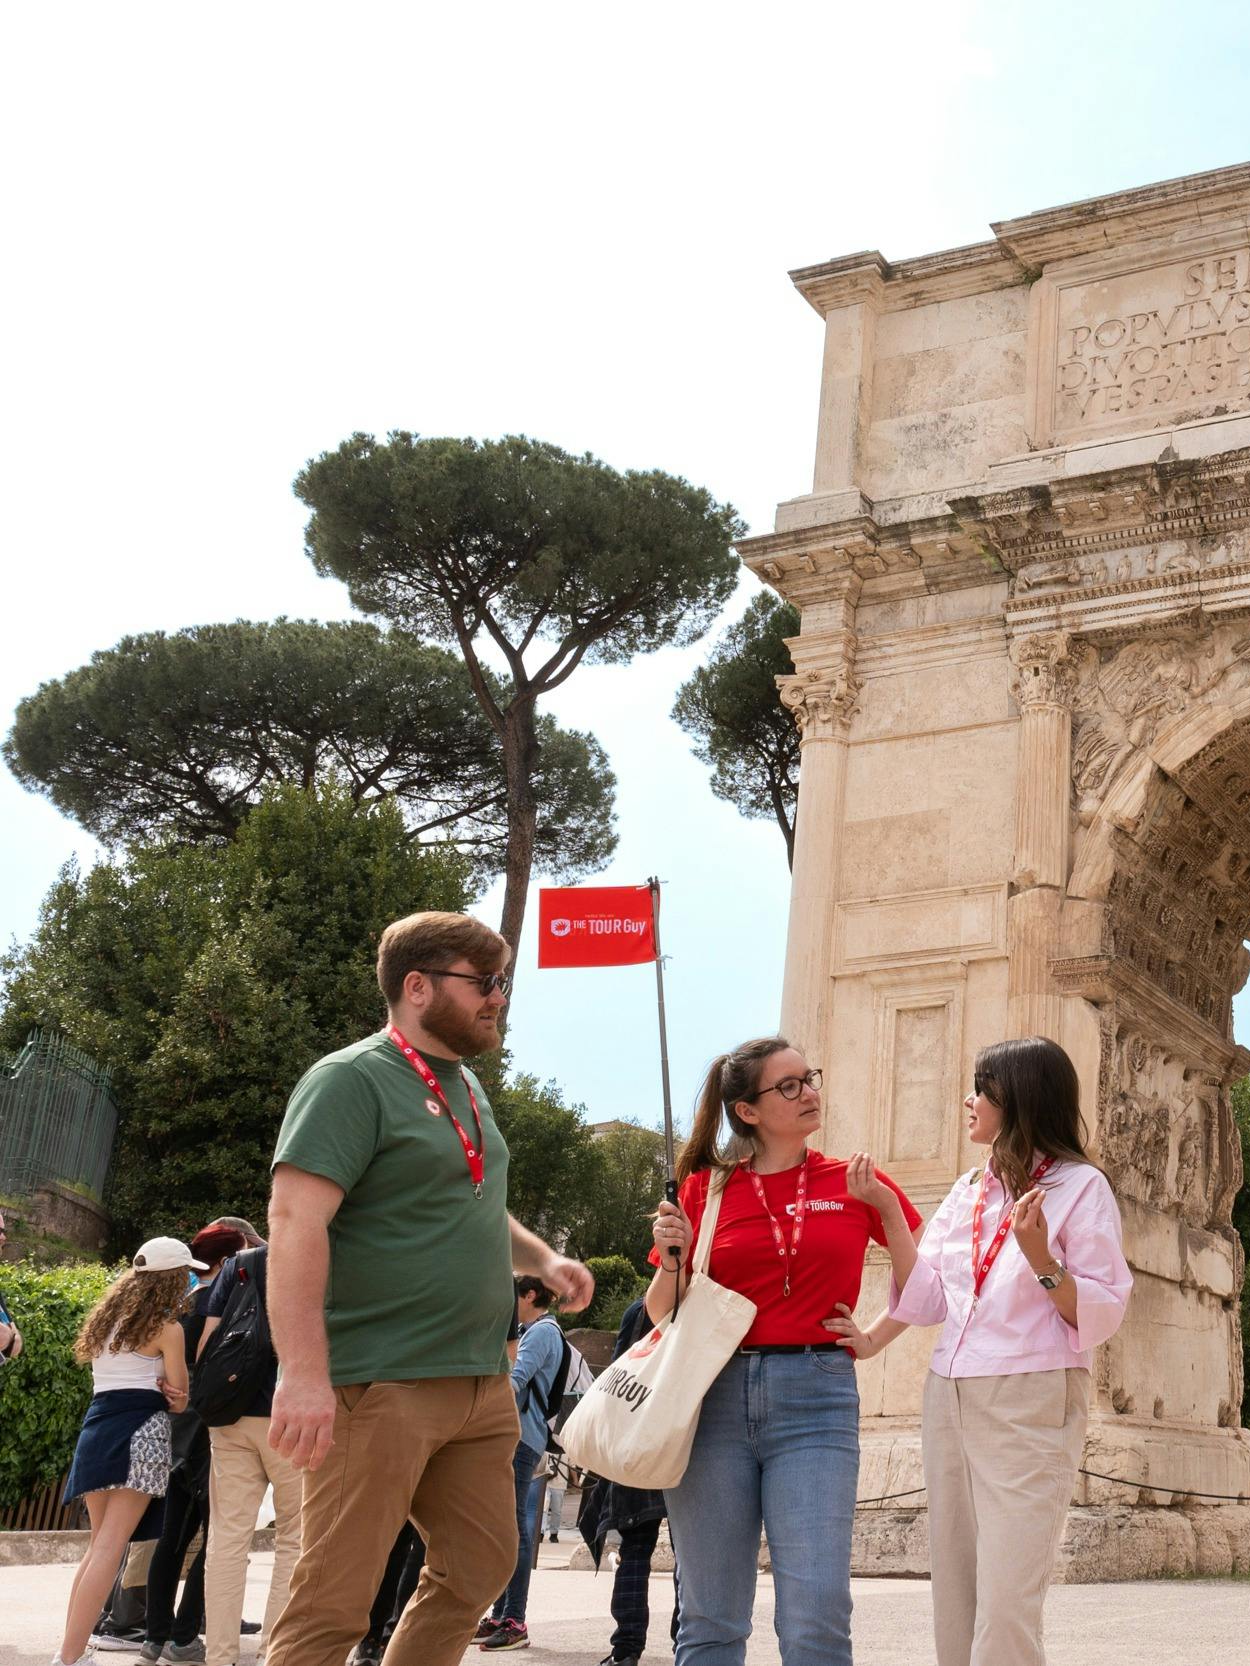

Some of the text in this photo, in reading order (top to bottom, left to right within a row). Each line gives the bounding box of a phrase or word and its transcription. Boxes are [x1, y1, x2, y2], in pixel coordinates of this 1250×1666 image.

[573, 918, 646, 936] THE TOUR Guy
[811, 1201, 830, 1211] TOUR
